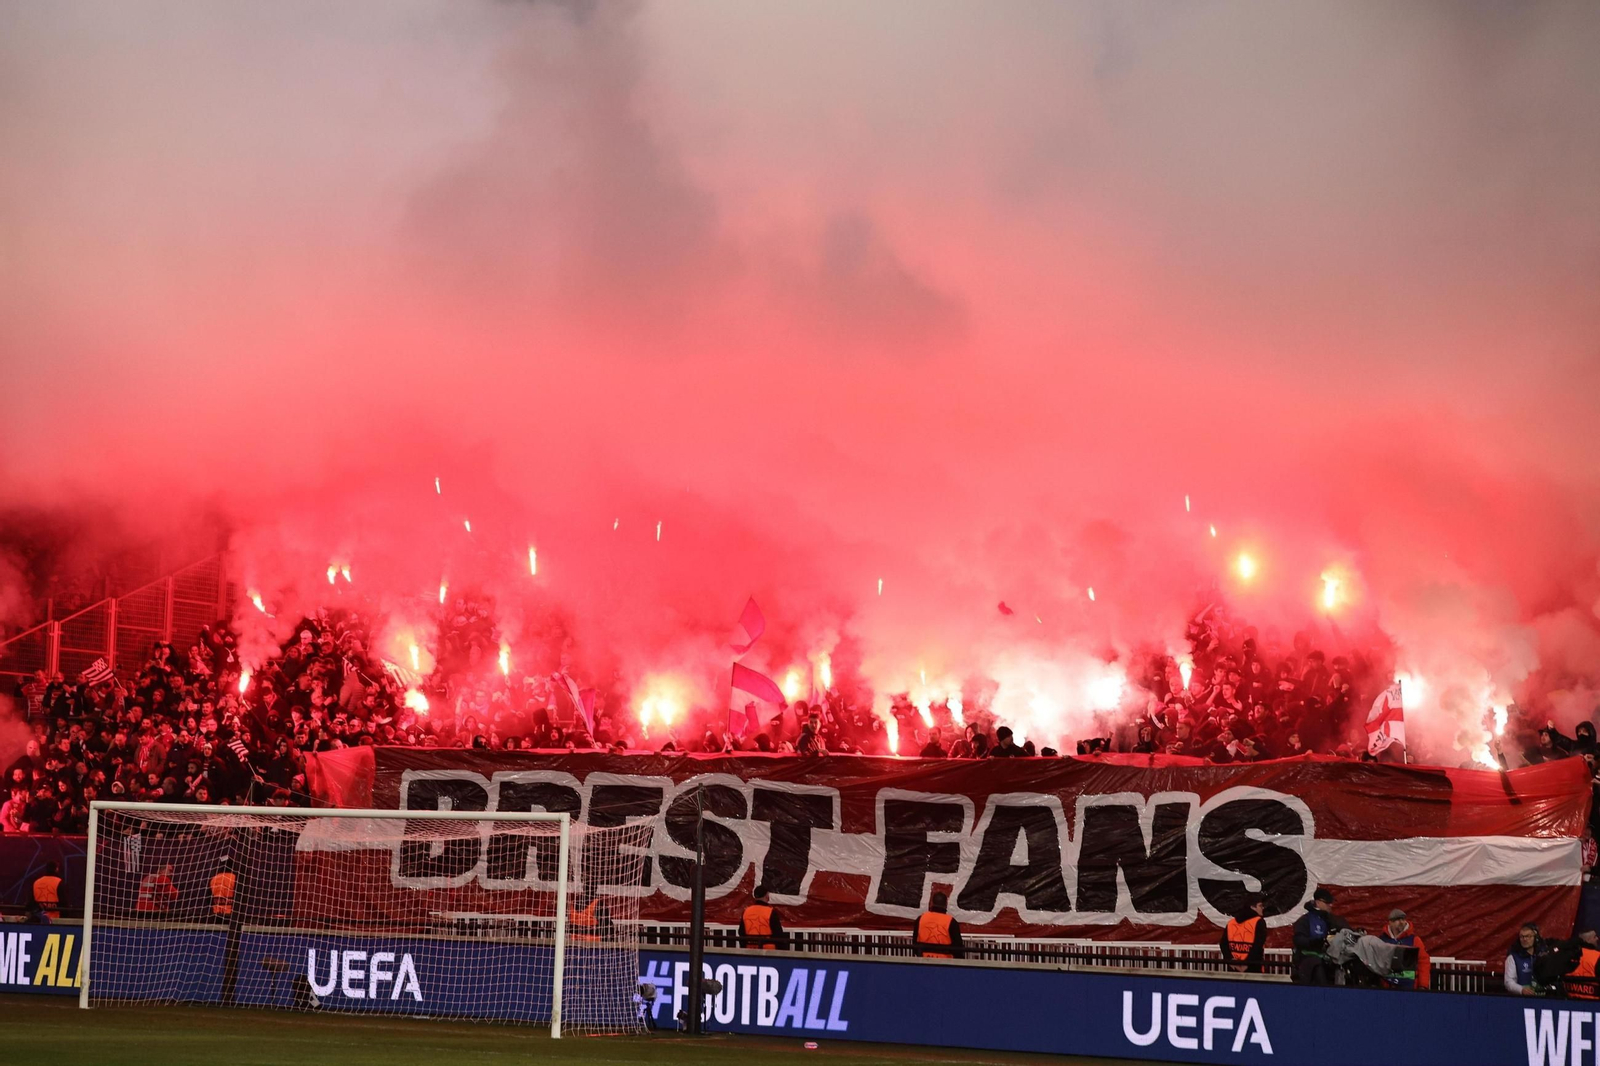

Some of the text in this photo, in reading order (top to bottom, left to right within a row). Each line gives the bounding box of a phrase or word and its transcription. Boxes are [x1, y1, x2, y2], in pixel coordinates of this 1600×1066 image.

[392, 769, 1314, 928] BREST FANS
[307, 948, 423, 1002] UEFA
[1122, 991, 1273, 1055] UEFA
[1523, 1008, 1600, 1066] WE
